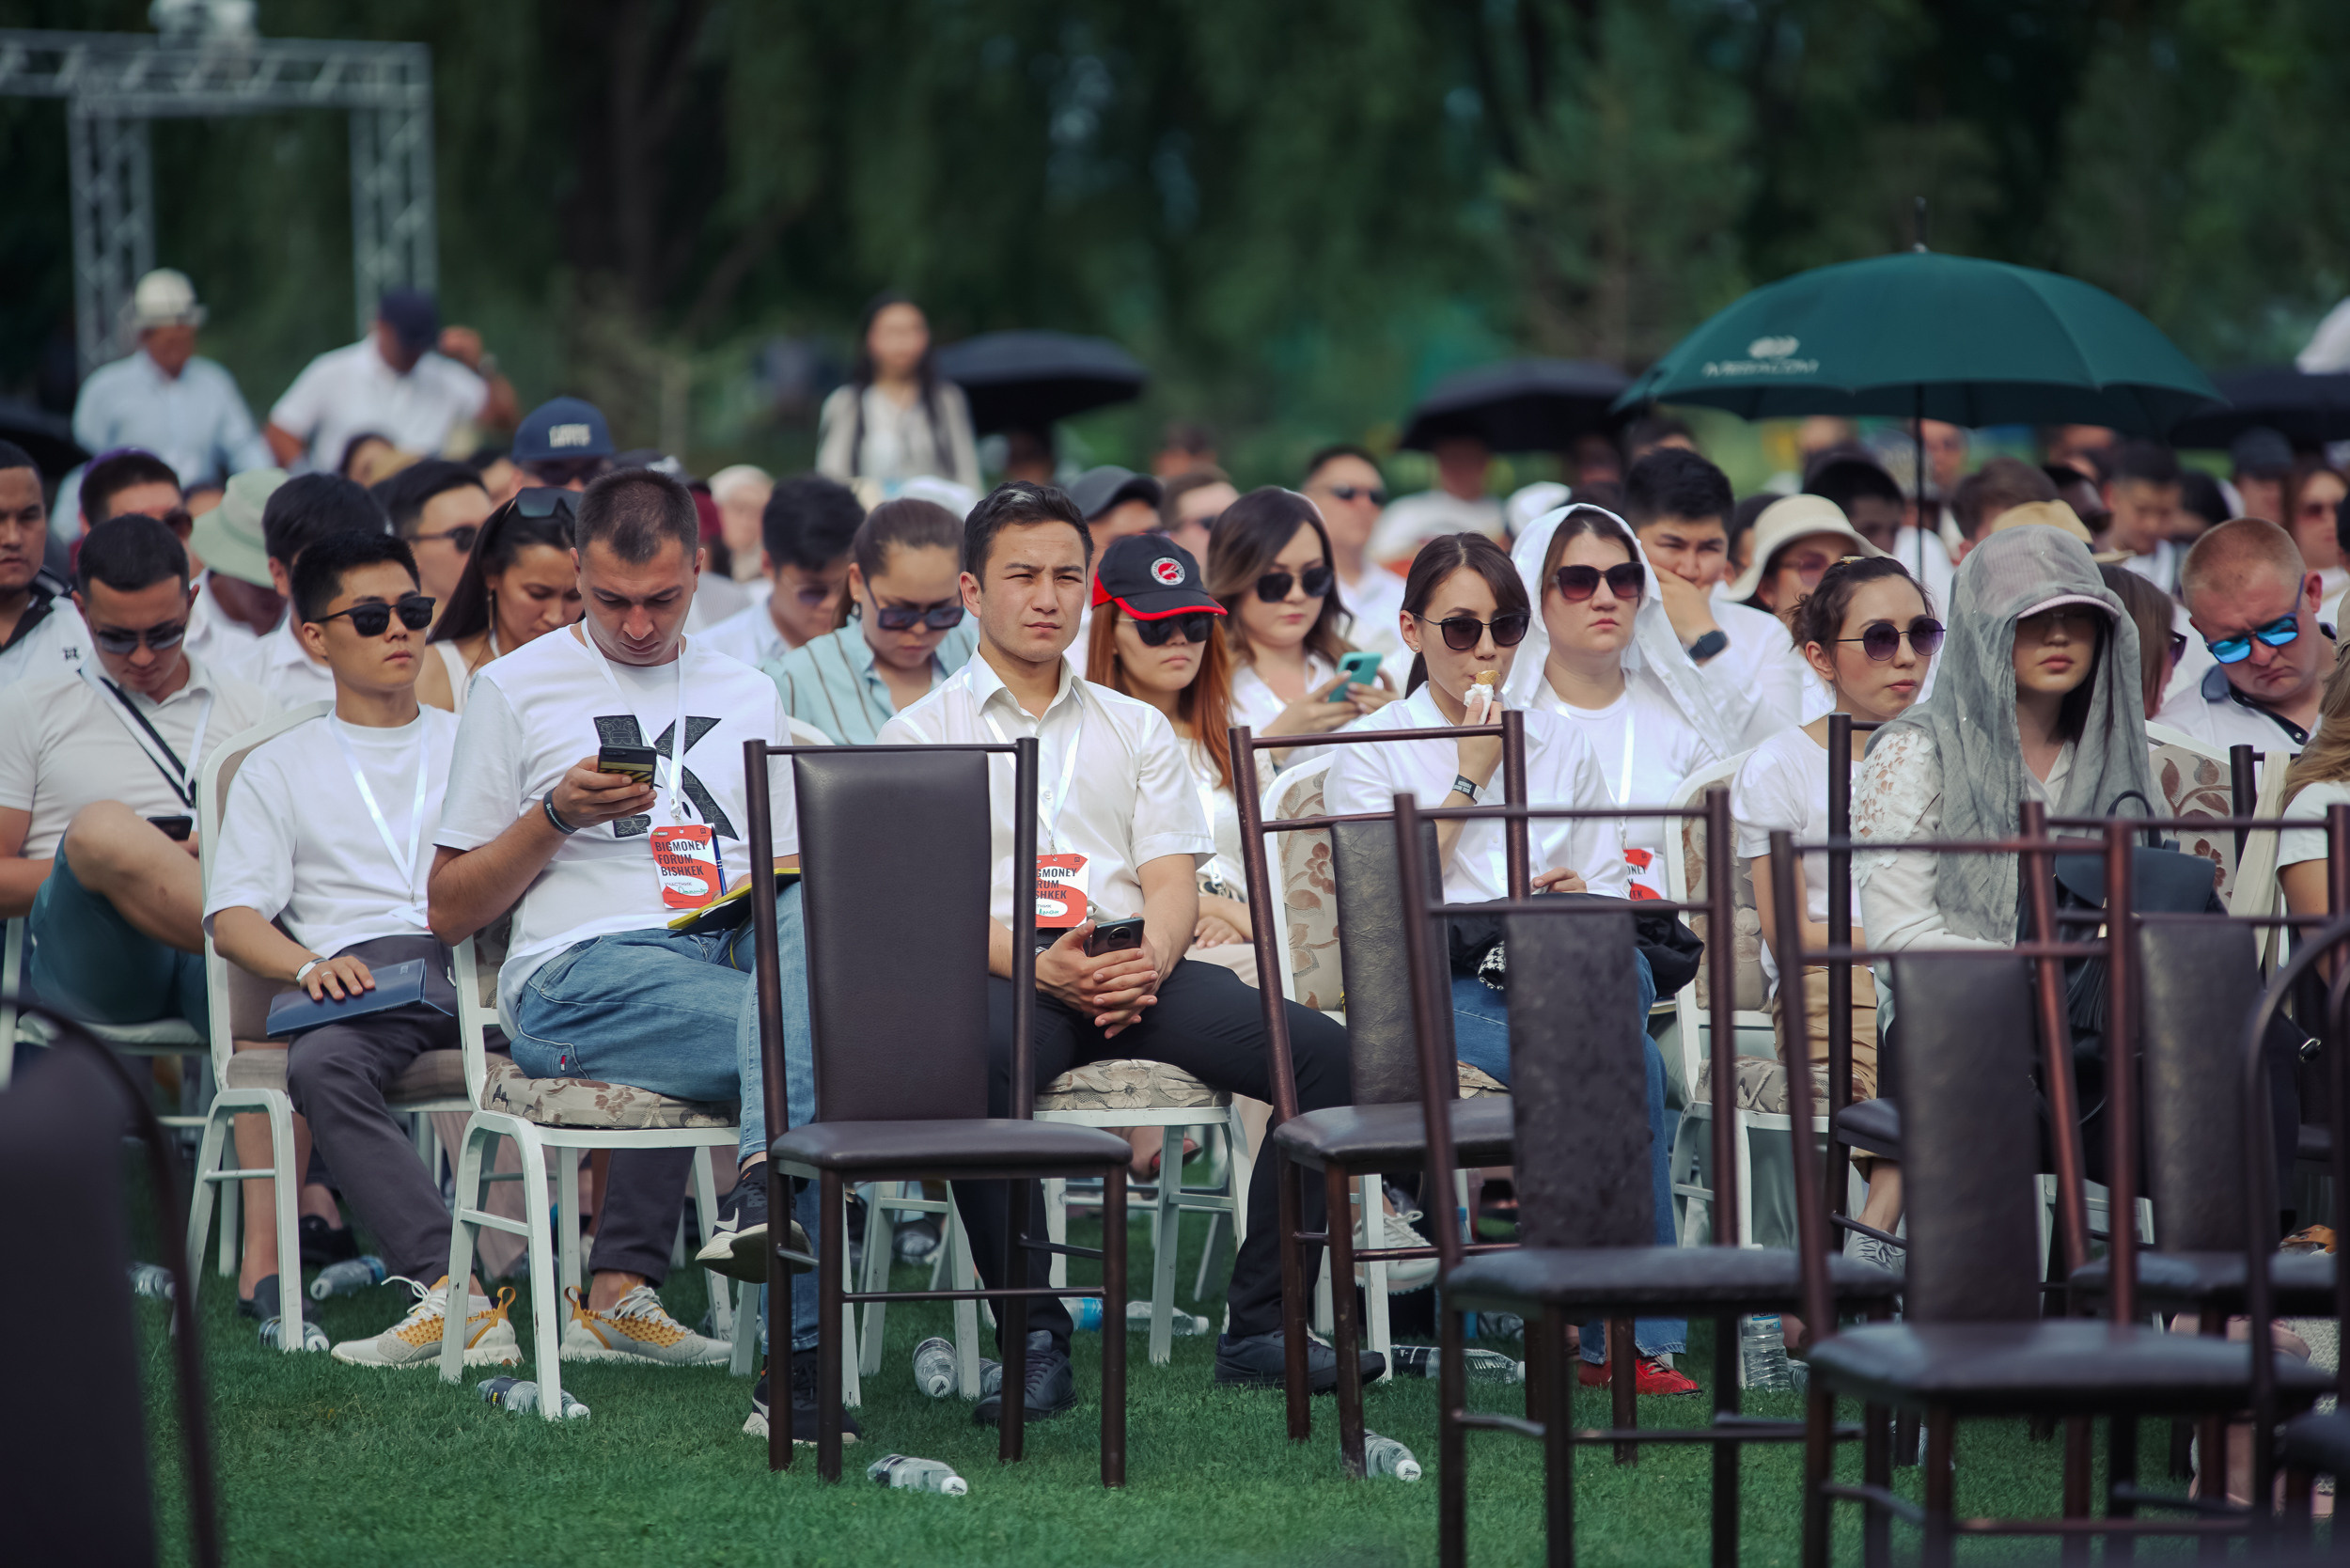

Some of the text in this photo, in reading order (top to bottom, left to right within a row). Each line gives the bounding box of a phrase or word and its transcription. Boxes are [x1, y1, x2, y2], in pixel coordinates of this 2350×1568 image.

[654, 839, 707, 852] BIGMONEY
[657, 854, 694, 864] FORUM
[661, 866, 704, 876] BISHKEK
[1036, 868, 1077, 878] GMONEY
[1037, 880, 1059, 889] RUM
[1035, 890, 1068, 900] SHKEK
